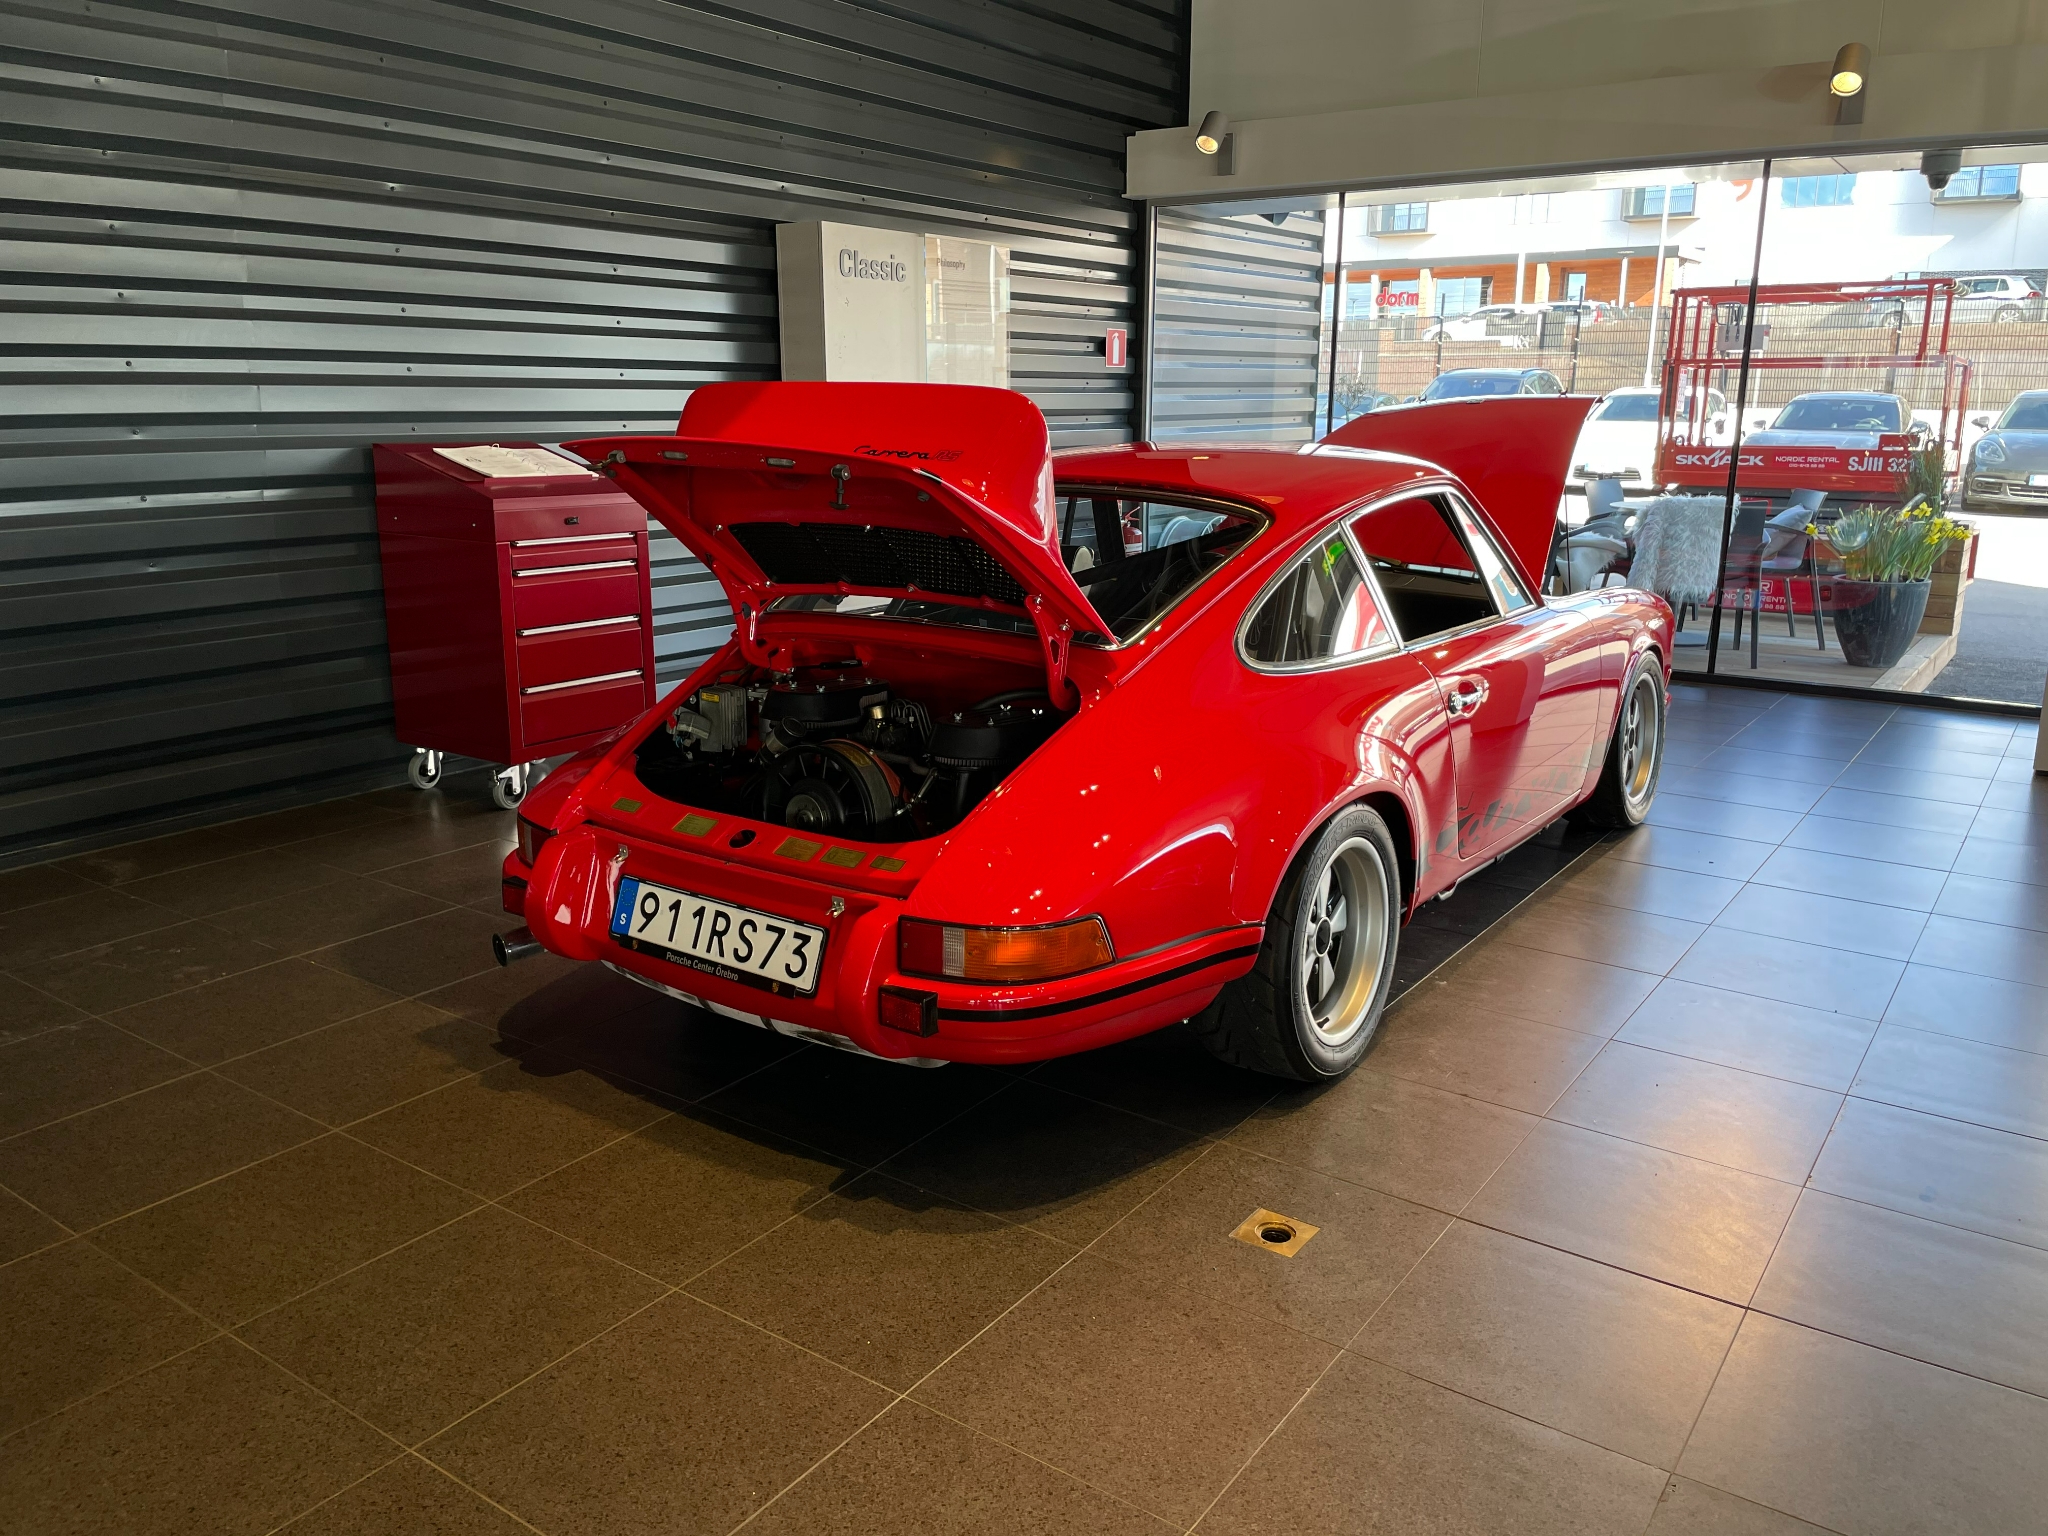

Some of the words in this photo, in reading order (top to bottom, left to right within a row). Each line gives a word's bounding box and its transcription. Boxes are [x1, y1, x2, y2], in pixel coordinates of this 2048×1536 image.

[839, 248, 907, 283] Classic
[936, 257, 966, 271] Philosophy
[853, 445, 930, 460] Carrera
[1675, 449, 1764, 467] SKYJACK
[1775, 455, 1806, 463] NORDIC
[1760, 595, 1796, 605] RENTL
[619, 913, 627, 925] S
[637, 891, 811, 978] 911RS73
[666, 951, 692, 967] Porsche
[692, 959, 714, 974] Center
[715, 965, 739, 981] Örebro
